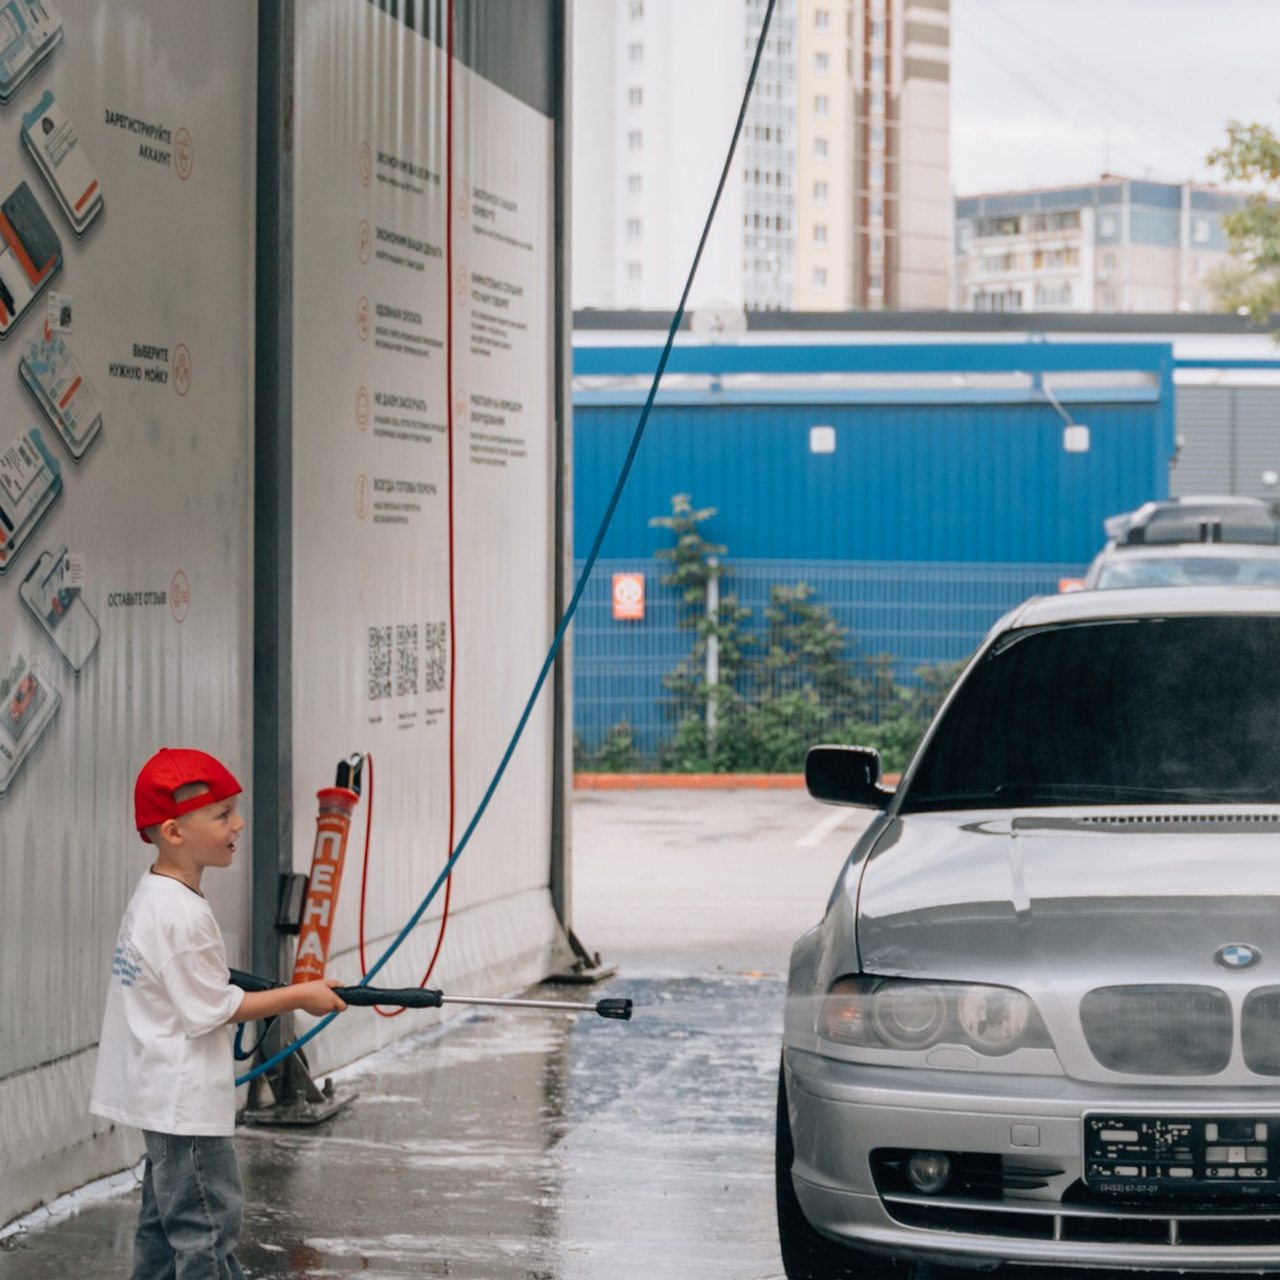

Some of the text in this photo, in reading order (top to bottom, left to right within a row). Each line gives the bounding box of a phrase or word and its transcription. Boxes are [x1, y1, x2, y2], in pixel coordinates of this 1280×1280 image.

[105, 109, 171, 145] ЗАРЕГИСТРИРУЙТЕ
[139, 144, 171, 167] АККАУНТ
[133, 343, 169, 362] ВЫБЕРИТЕ
[109, 363, 169, 384] НУЖНУЮ МОЙКУ
[108, 591, 167, 607] ОСТАВЬТЕ ОТЗЫВ
[297, 831, 342, 962] ПЕНА
